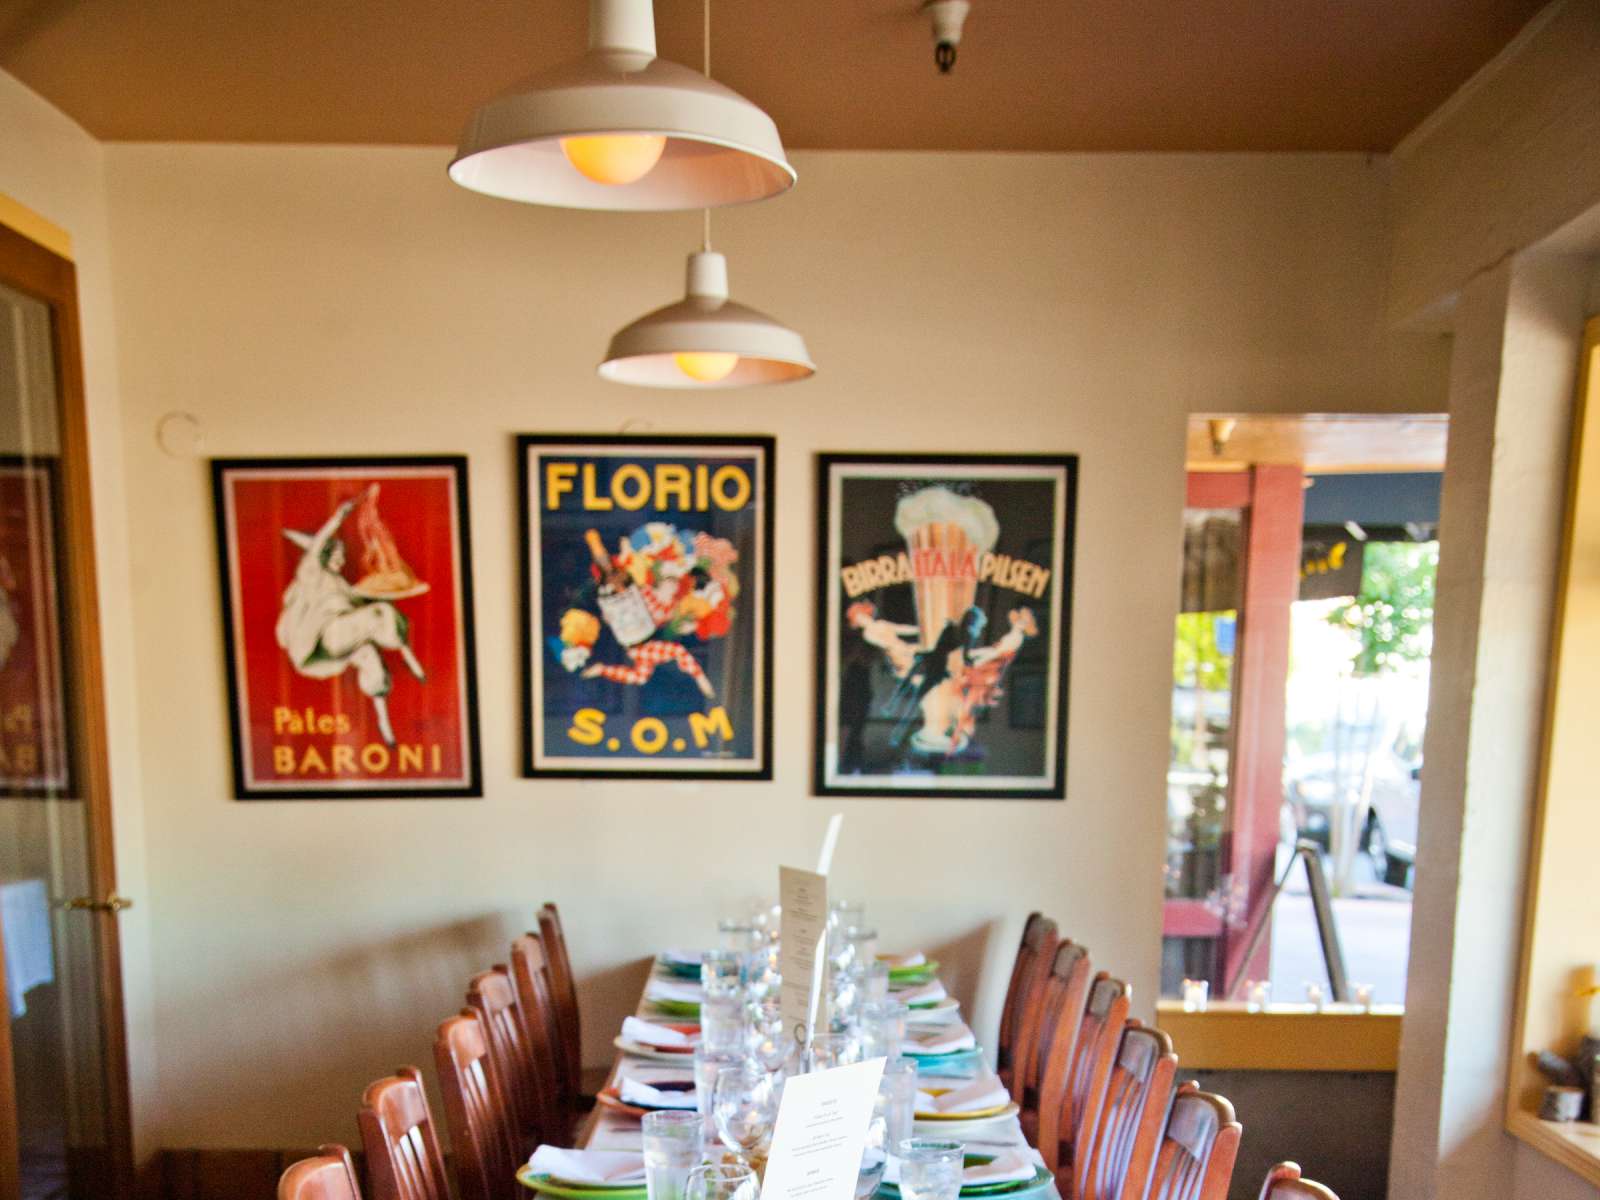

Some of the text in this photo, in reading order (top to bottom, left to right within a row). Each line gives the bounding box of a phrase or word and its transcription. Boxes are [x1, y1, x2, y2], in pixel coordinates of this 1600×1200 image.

[546, 463, 751, 511] FLORIO
[841, 551, 913, 598] BIRRA
[980, 551, 1051, 599] PILSEN
[274, 744, 441, 774] BARONI
